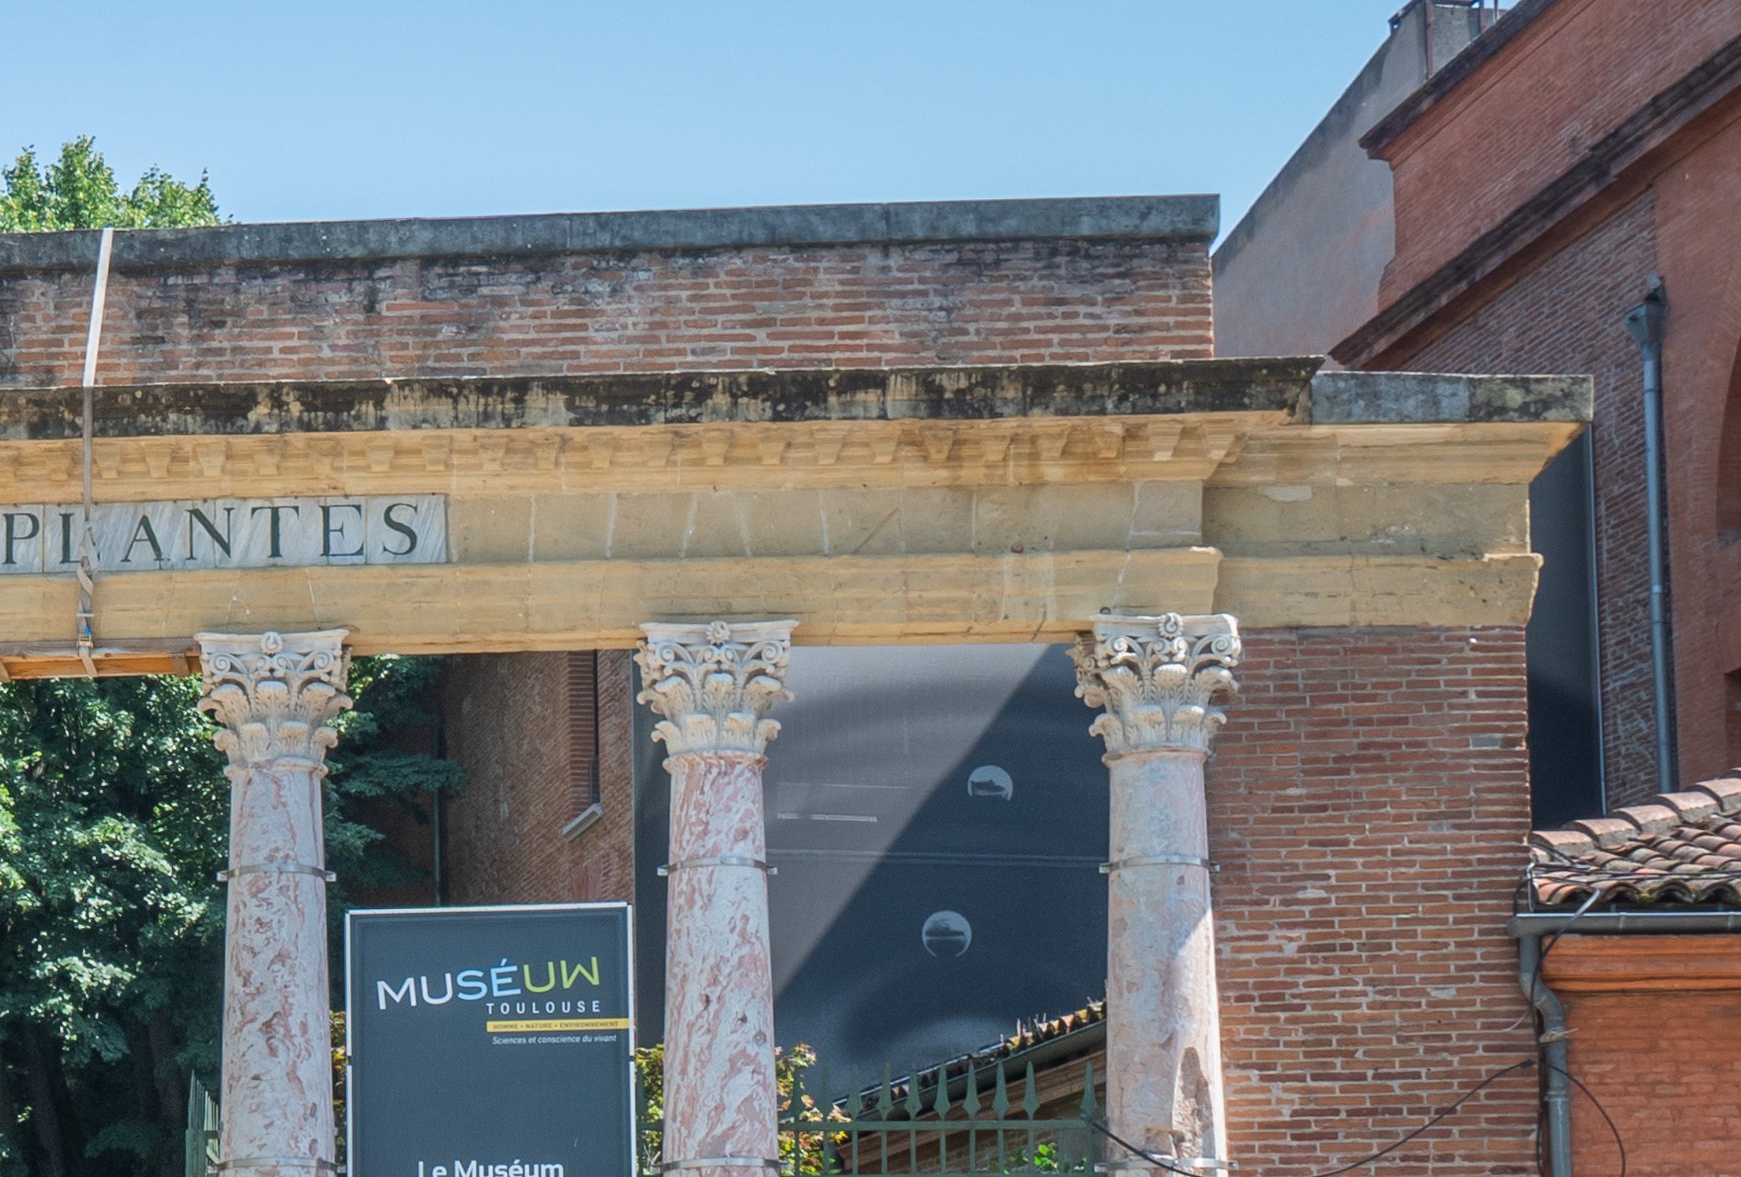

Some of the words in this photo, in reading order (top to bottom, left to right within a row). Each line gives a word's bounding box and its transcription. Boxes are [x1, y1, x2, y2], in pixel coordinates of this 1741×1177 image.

[2, 503, 418, 565] PLANTES
[486, 1001, 601, 1015] TOULOUSE
[559, 1020, 619, 1028] ENVIRONNEMENT
[492, 1036, 526, 1045] Sciences
[537, 1035, 581, 1043] conscience
[582, 1034, 593, 1043] du
[594, 1034, 617, 1042] vivant
